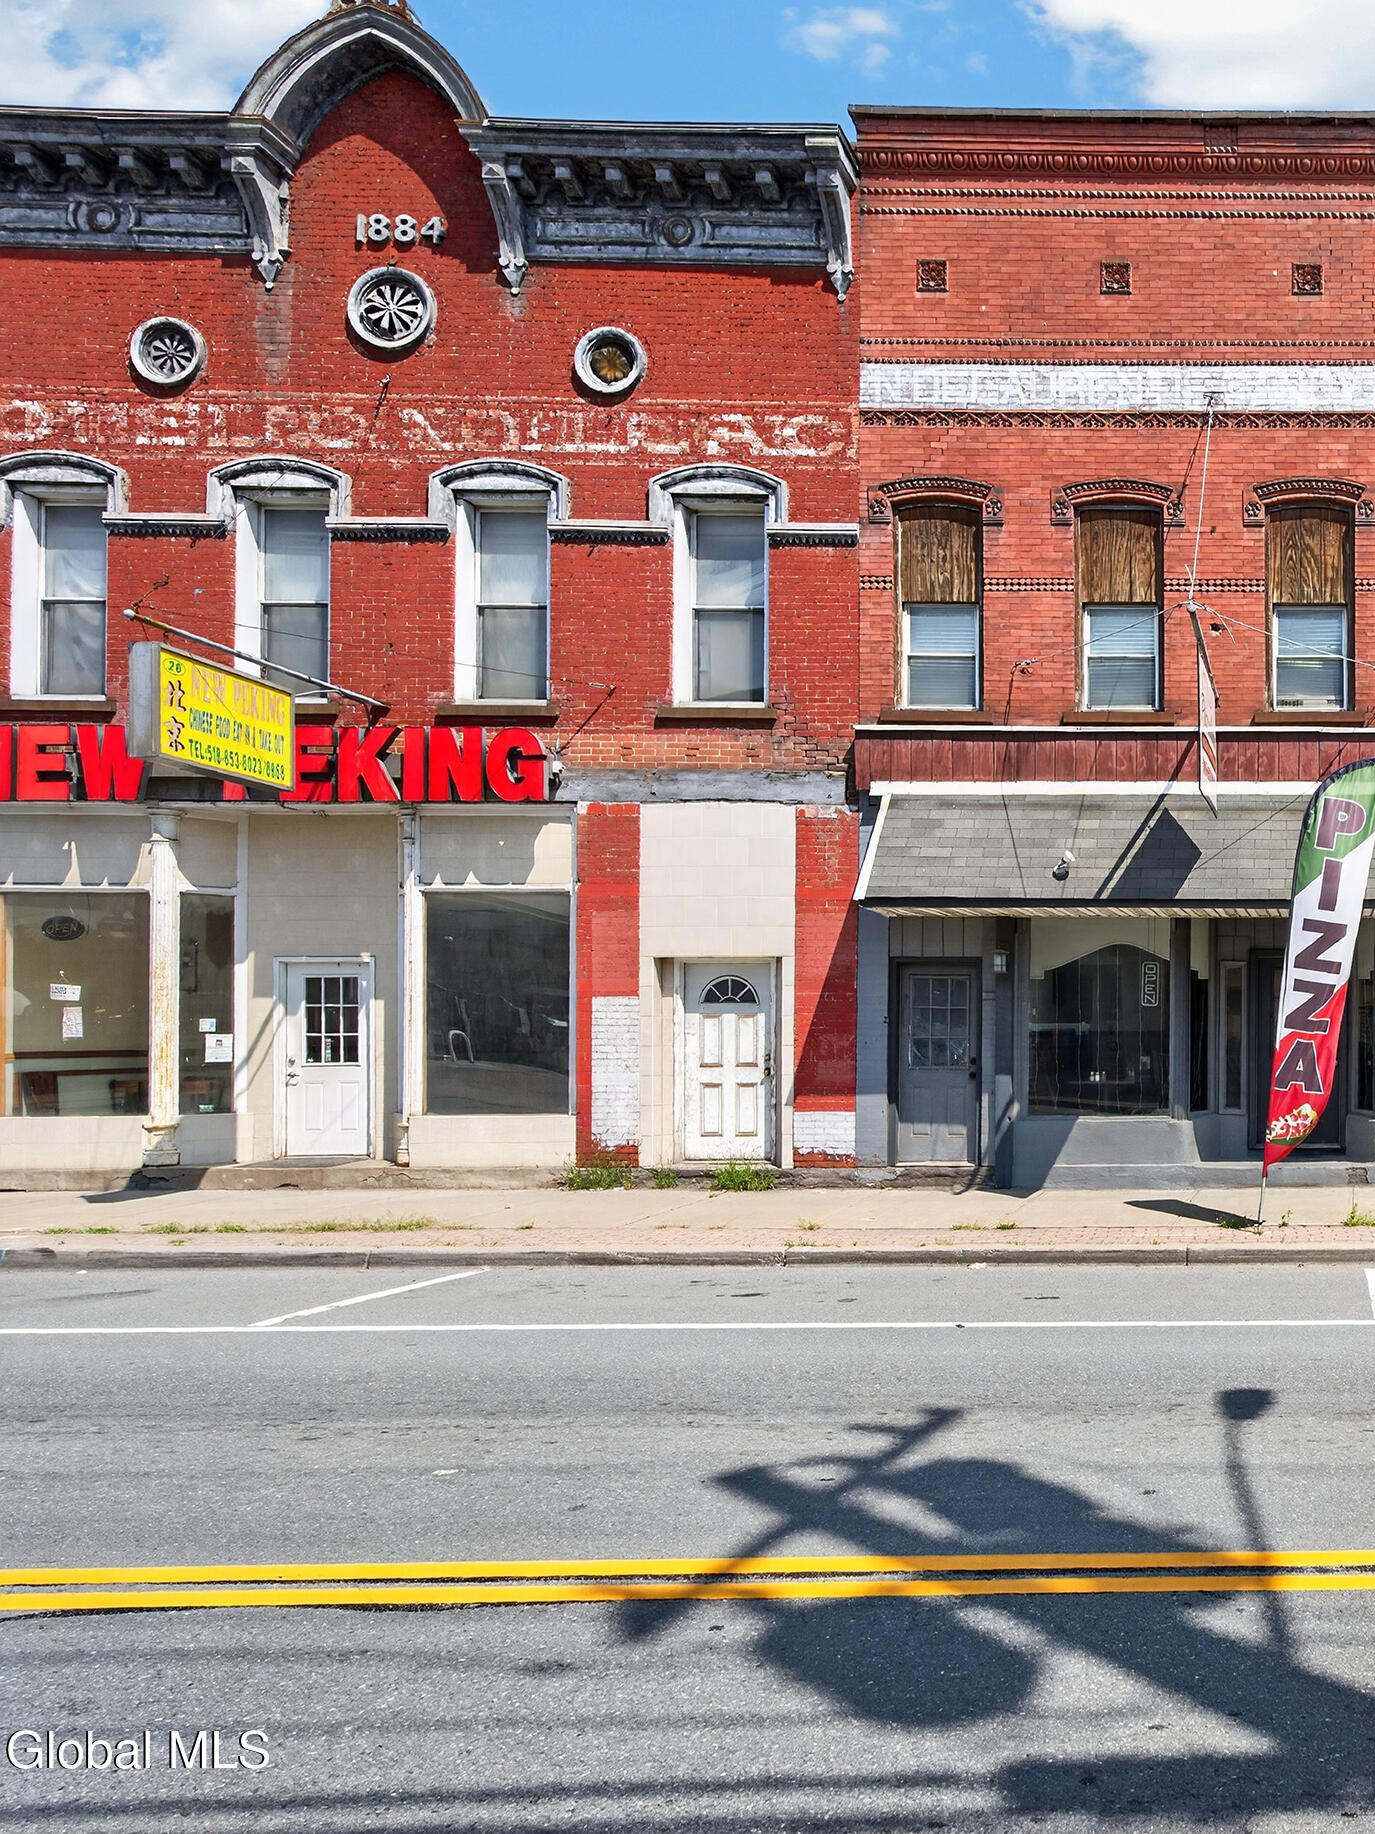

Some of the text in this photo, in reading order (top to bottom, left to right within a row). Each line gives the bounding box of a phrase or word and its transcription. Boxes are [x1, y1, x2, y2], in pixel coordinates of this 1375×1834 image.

[356, 213, 445, 244] 1884
[164, 680, 187, 752] 北京
[191, 665, 285, 726] NEW PEKING
[189, 707, 213, 734] CHINESE
[216, 715, 231, 739] FOOD
[259, 730, 271, 752] TAKE
[274, 735, 284, 755] OUT
[0, 724, 546, 802] EW EKING
[1274, 797, 1367, 1095] PIZZA
[1144, 964, 1157, 1004] OPEN
